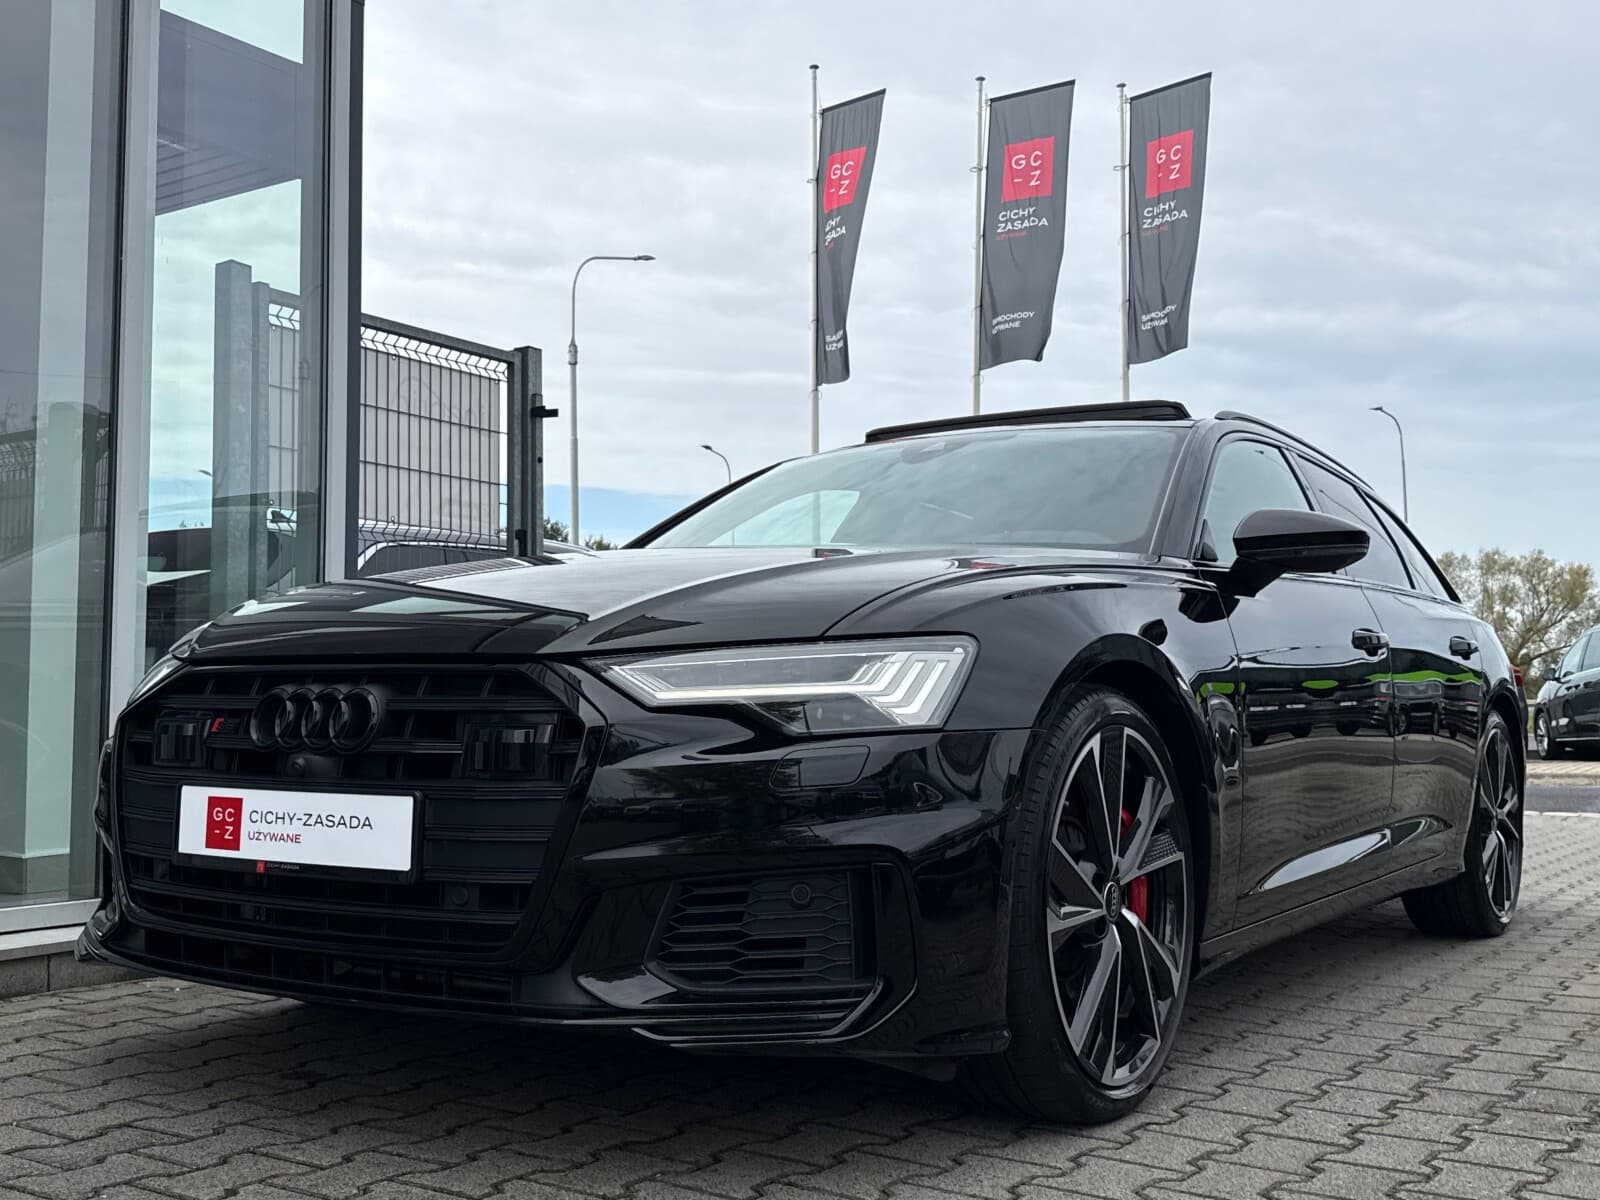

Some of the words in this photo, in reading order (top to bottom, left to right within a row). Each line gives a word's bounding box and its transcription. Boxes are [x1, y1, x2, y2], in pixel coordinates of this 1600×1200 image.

[1011, 150, 1043, 170] GC
[1156, 145, 1182, 165] GC
[830, 160, 855, 180] GC
[998, 206, 1036, 221] CICHY
[996, 217, 1049, 233] ZASADA
[213, 807, 235, 822] GC
[249, 809, 374, 831] CICHY-ZASADA
